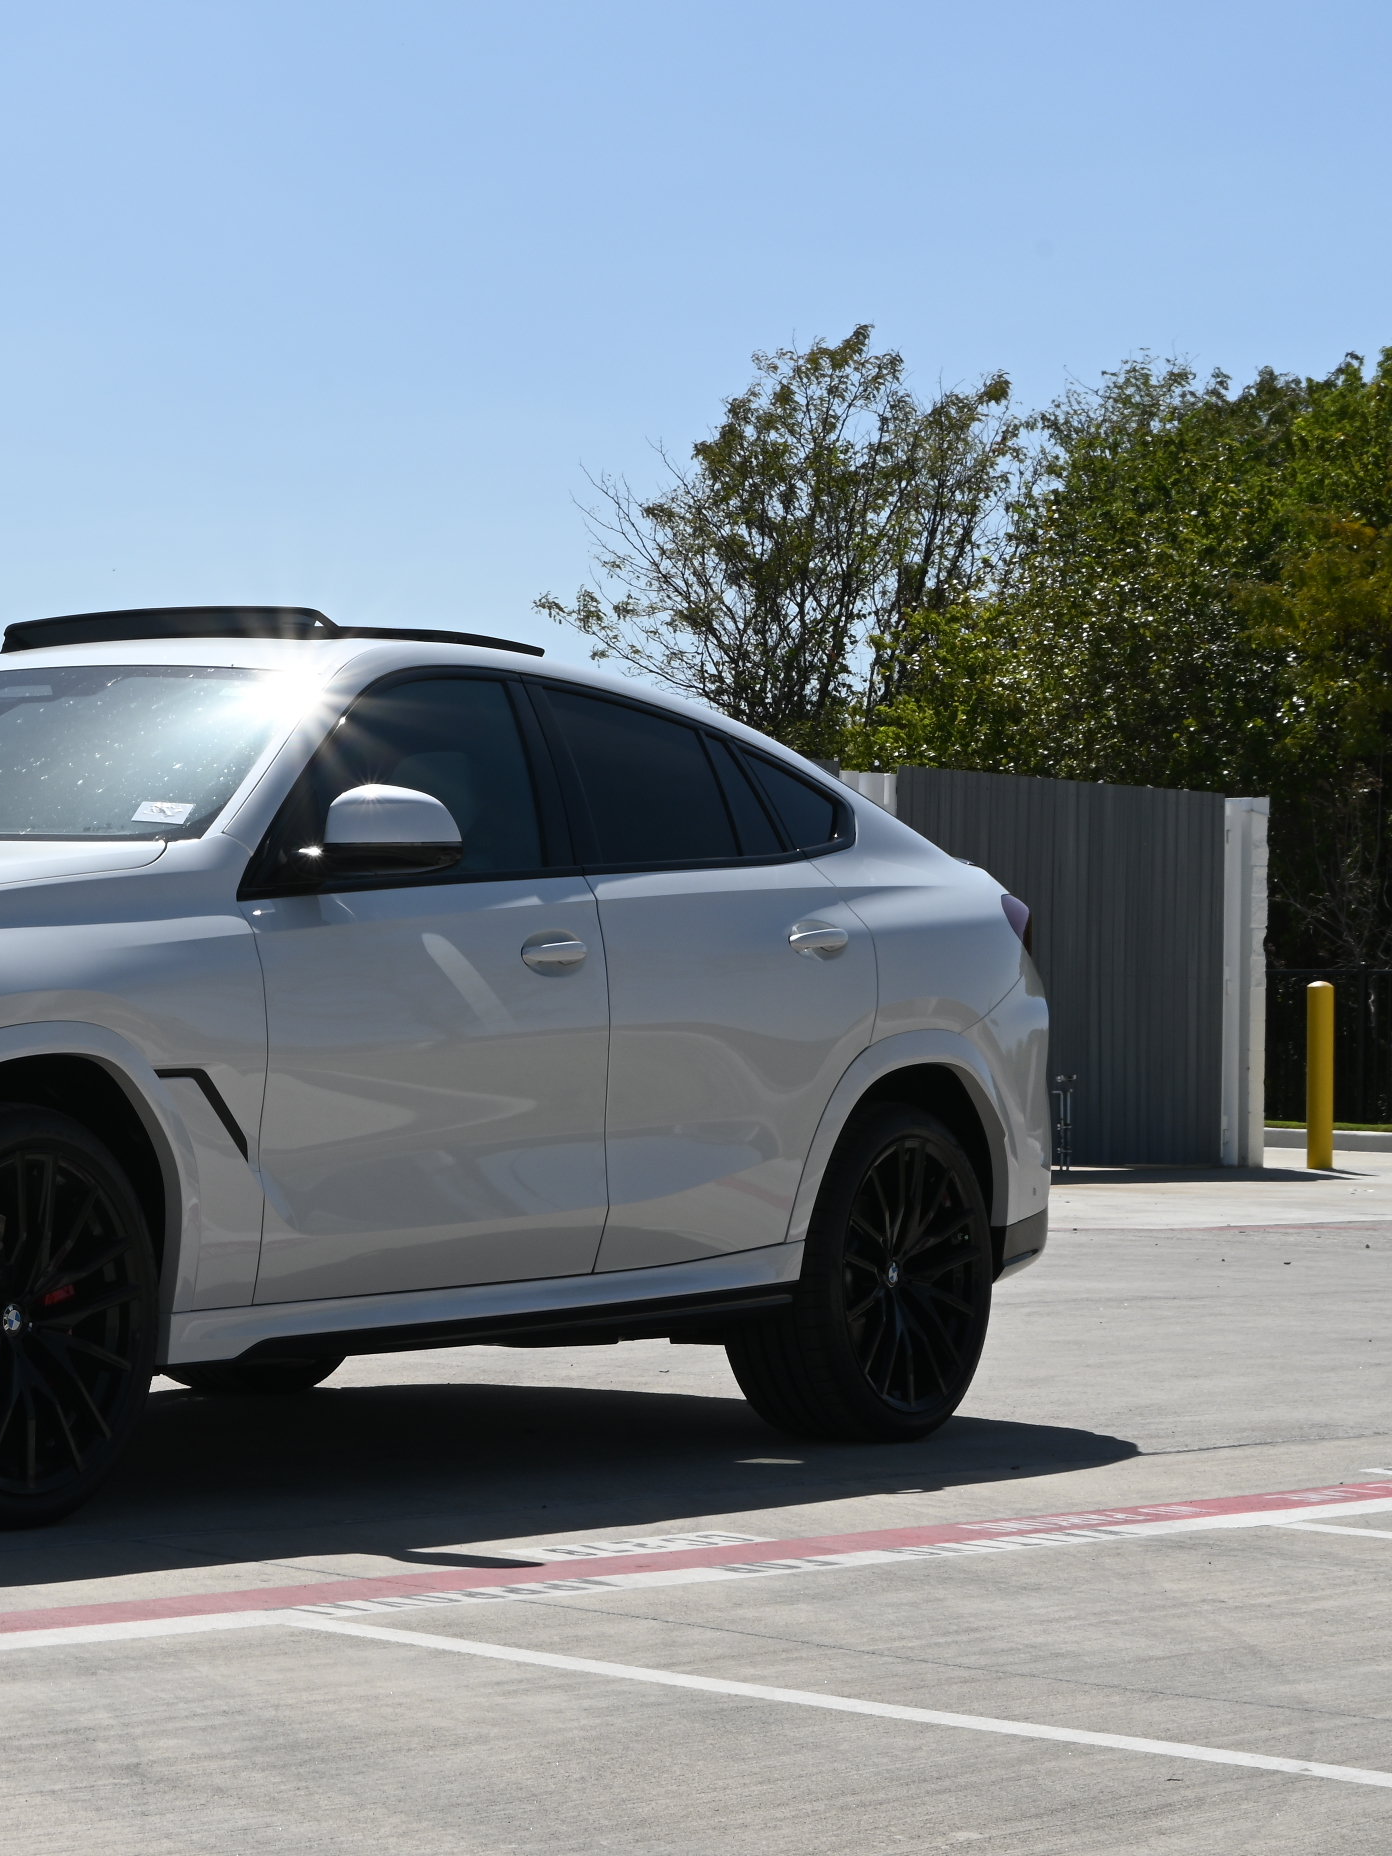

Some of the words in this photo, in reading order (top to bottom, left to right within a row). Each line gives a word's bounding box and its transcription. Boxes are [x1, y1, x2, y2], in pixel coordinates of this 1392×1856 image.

[958, 1511, 1152, 1532] PARKING
[880, 1528, 1140, 1555] WAITING
[711, 1558, 843, 1574] FOR
[264, 1577, 623, 1615] APPROVAL
